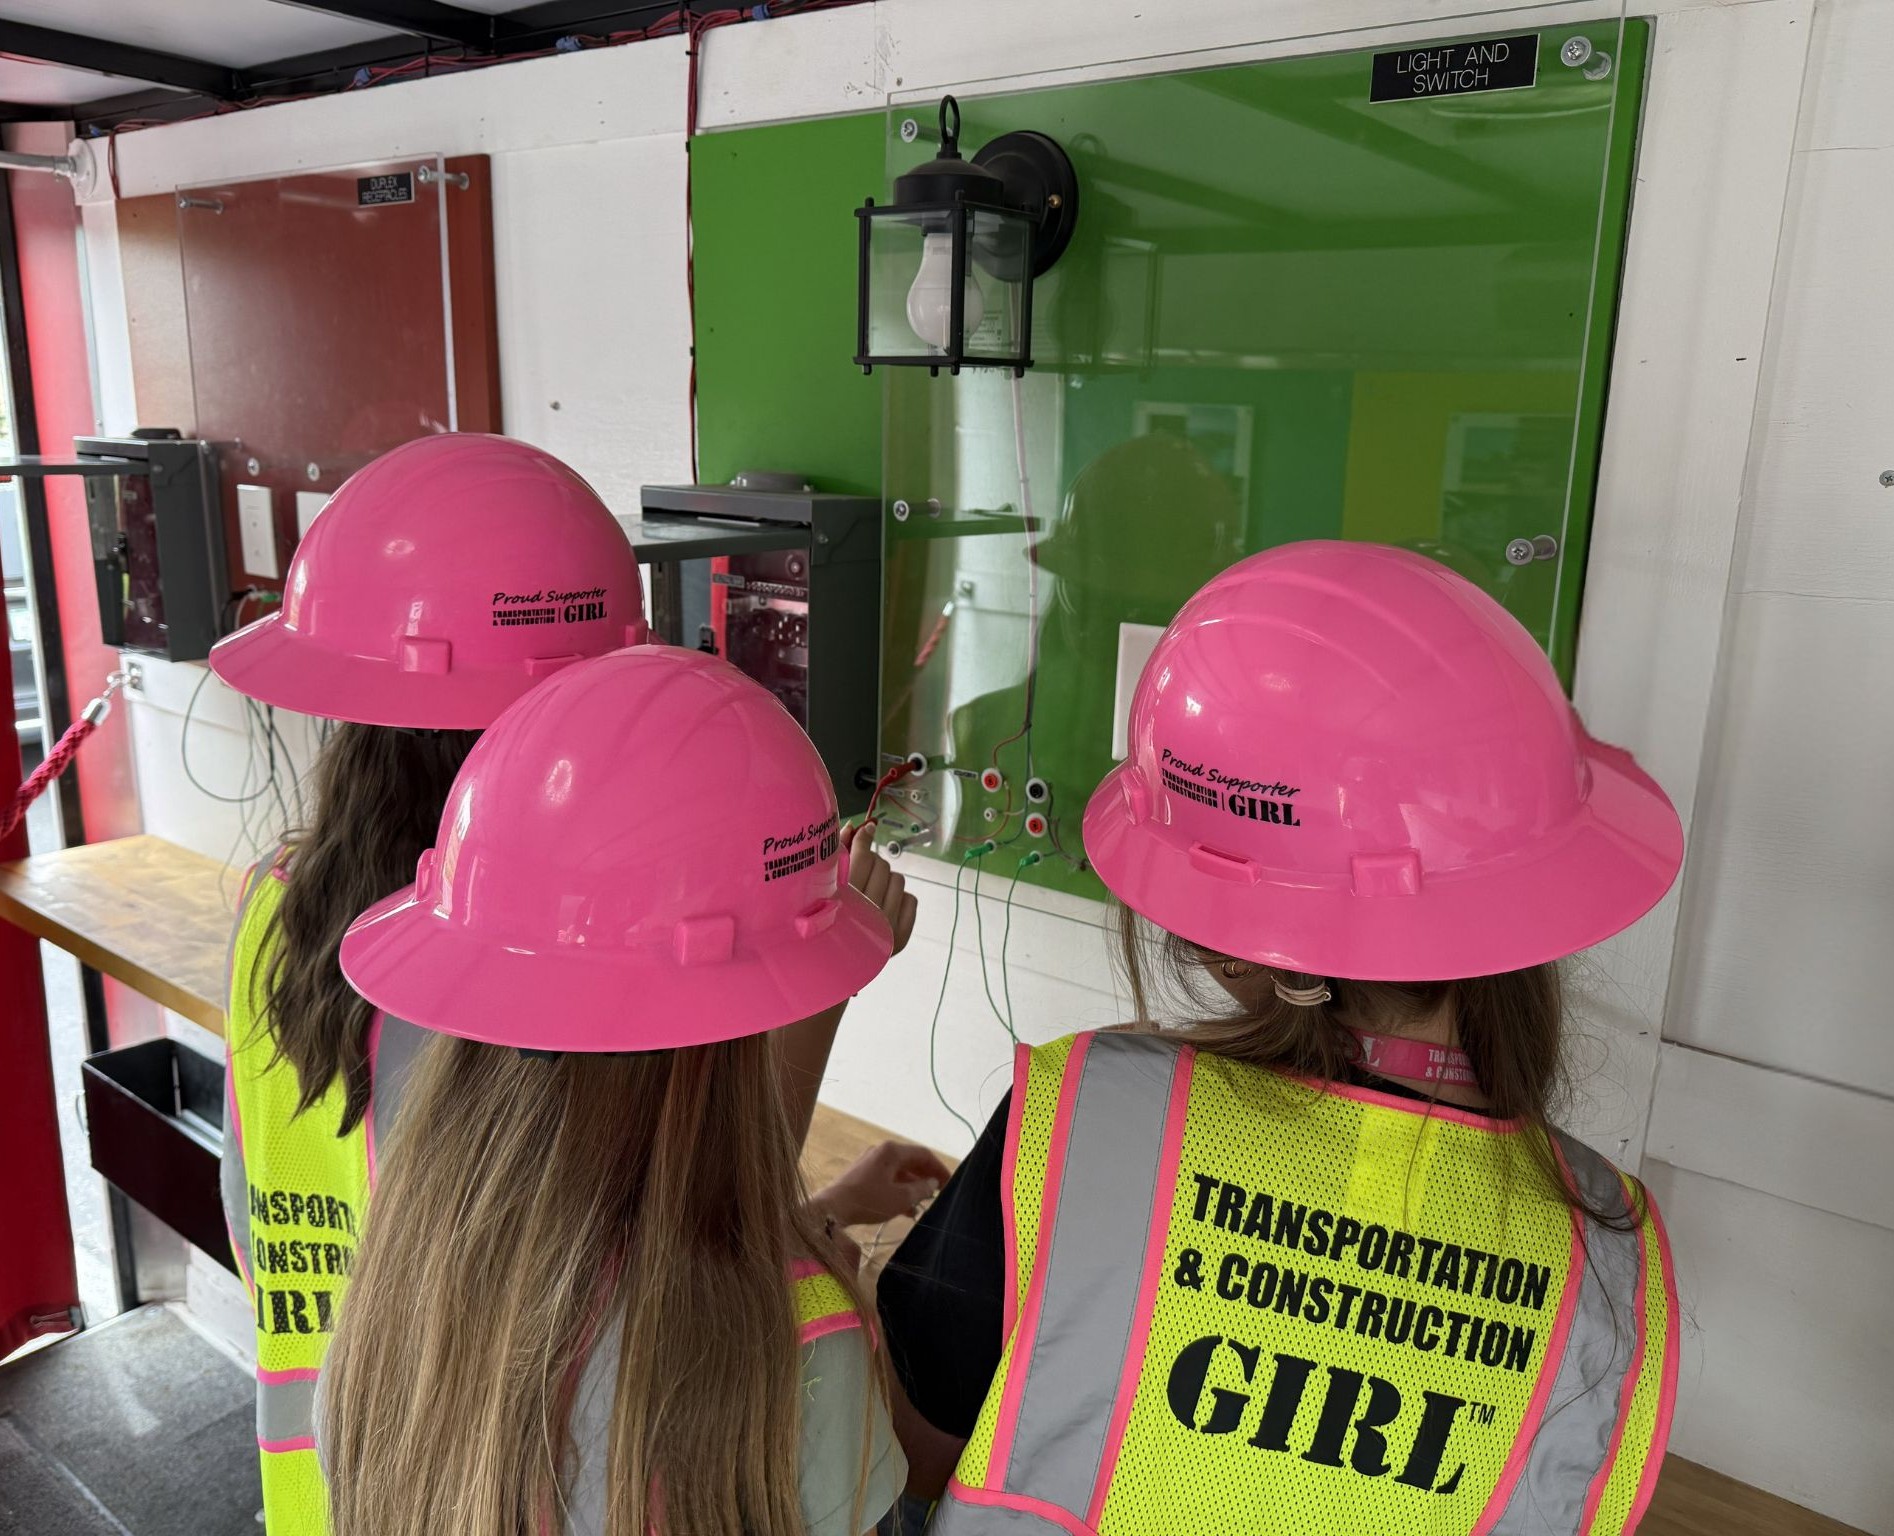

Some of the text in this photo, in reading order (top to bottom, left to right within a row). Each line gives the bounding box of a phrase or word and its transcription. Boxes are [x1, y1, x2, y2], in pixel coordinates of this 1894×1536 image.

[1396, 42, 1510, 74] LIGHT AND
[1412, 67, 1490, 94] SWITCH
[492, 587, 608, 605] Proud Supporter
[492, 608, 556, 618] TRANSPORTATION
[500, 616, 555, 626] CONSTRUCTION
[564, 602, 608, 624] GIRL
[1161, 748, 1301, 798] Proud Supporter
[1161, 768, 1218, 798] TRANSPORTATION
[1167, 781, 1218, 809] CONSTRUCTION
[1228, 794, 1301, 827] GIRL
[763, 829, 806, 855] Proud
[764, 846, 815, 871] TRANSPORTATION
[772, 856, 815, 880] CONSTRUCTION
[1425, 1067, 1433, 1078] &
[1192, 1171, 1551, 1311] TRANSPORTATION
[1173, 1247, 1535, 1373] & CONSTRUCTION
[1165, 1334, 1467, 1496] GIRL
